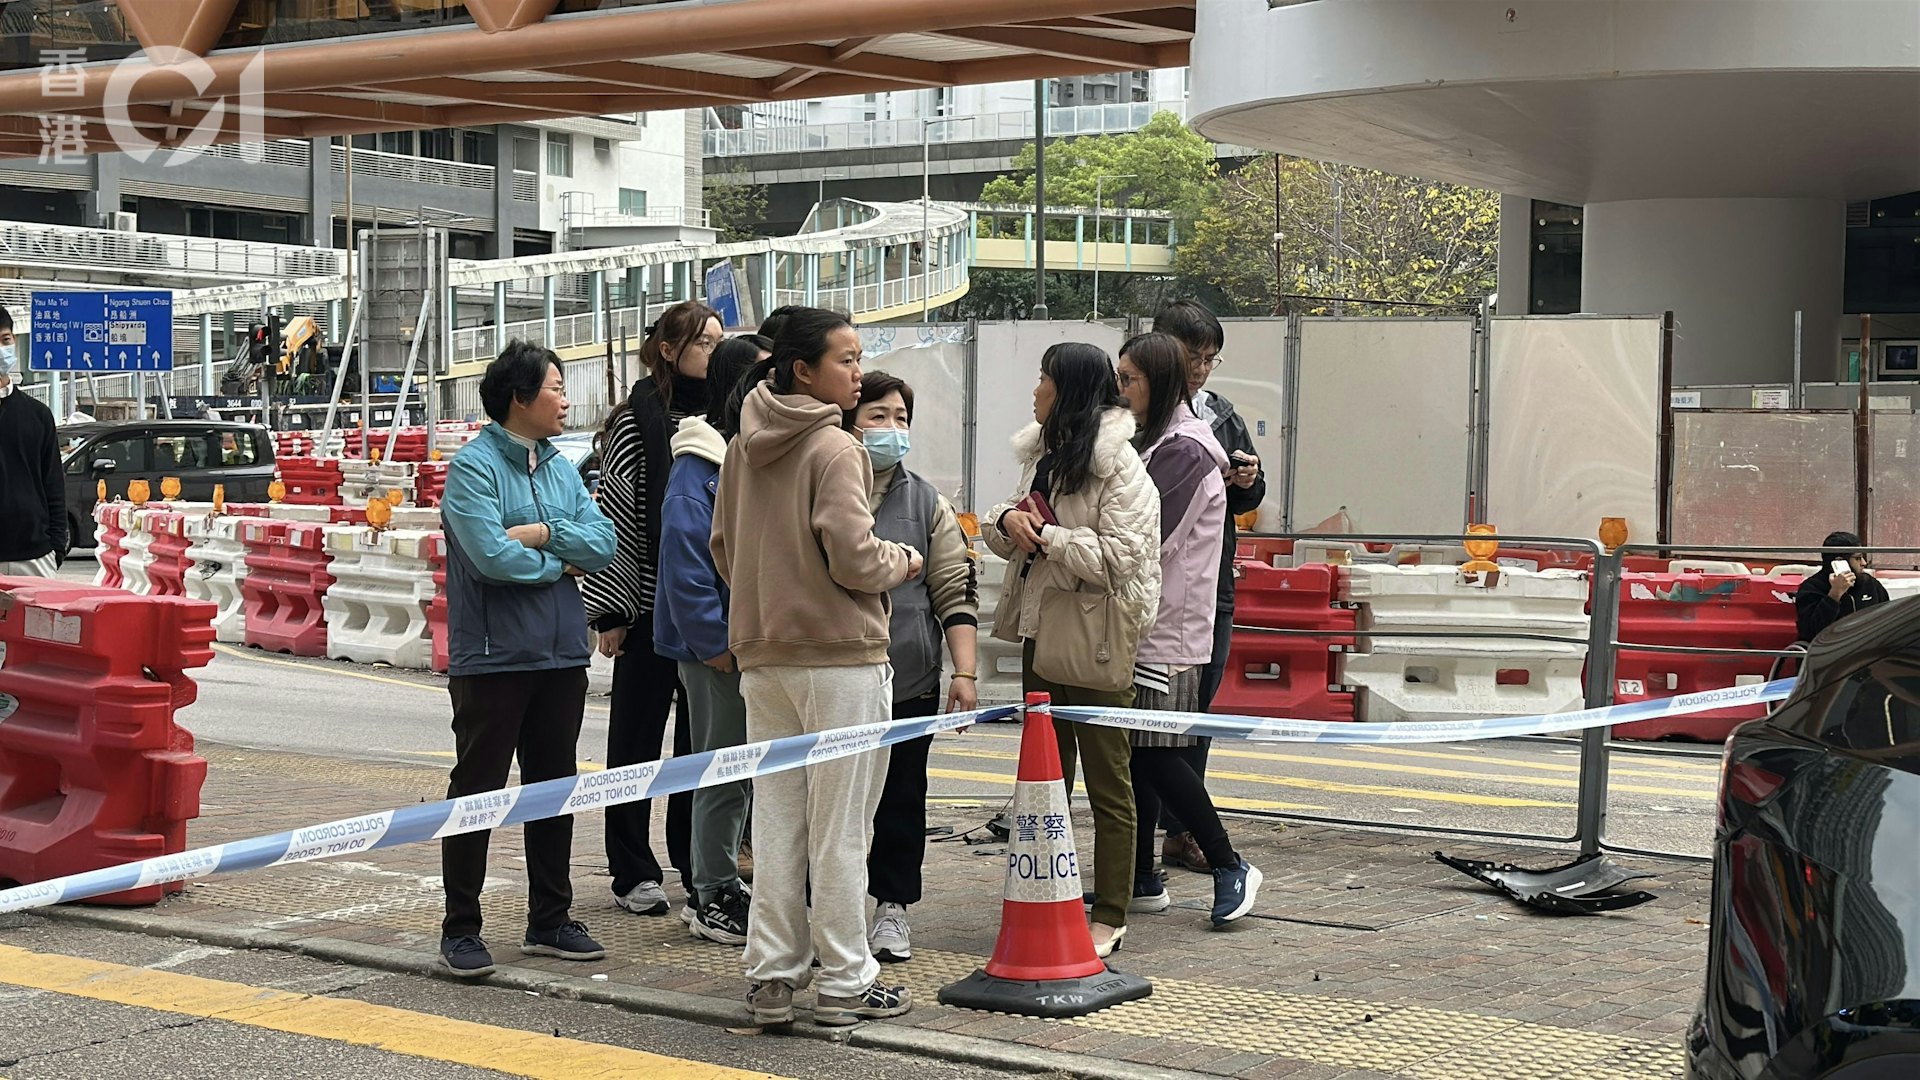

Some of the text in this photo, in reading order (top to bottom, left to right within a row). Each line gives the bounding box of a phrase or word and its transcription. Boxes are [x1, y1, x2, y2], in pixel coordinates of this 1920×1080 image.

[109, 299, 130, 308] Ngong
[153, 298, 170, 306] Chau
[34, 320, 83, 330] Hong Kong (W)
[35, 332, 68, 343] 香港(西)
[1016, 812, 1066, 842] 警察
[1009, 852, 1078, 880] POLICE
[1036, 994, 1083, 1006] TKW
